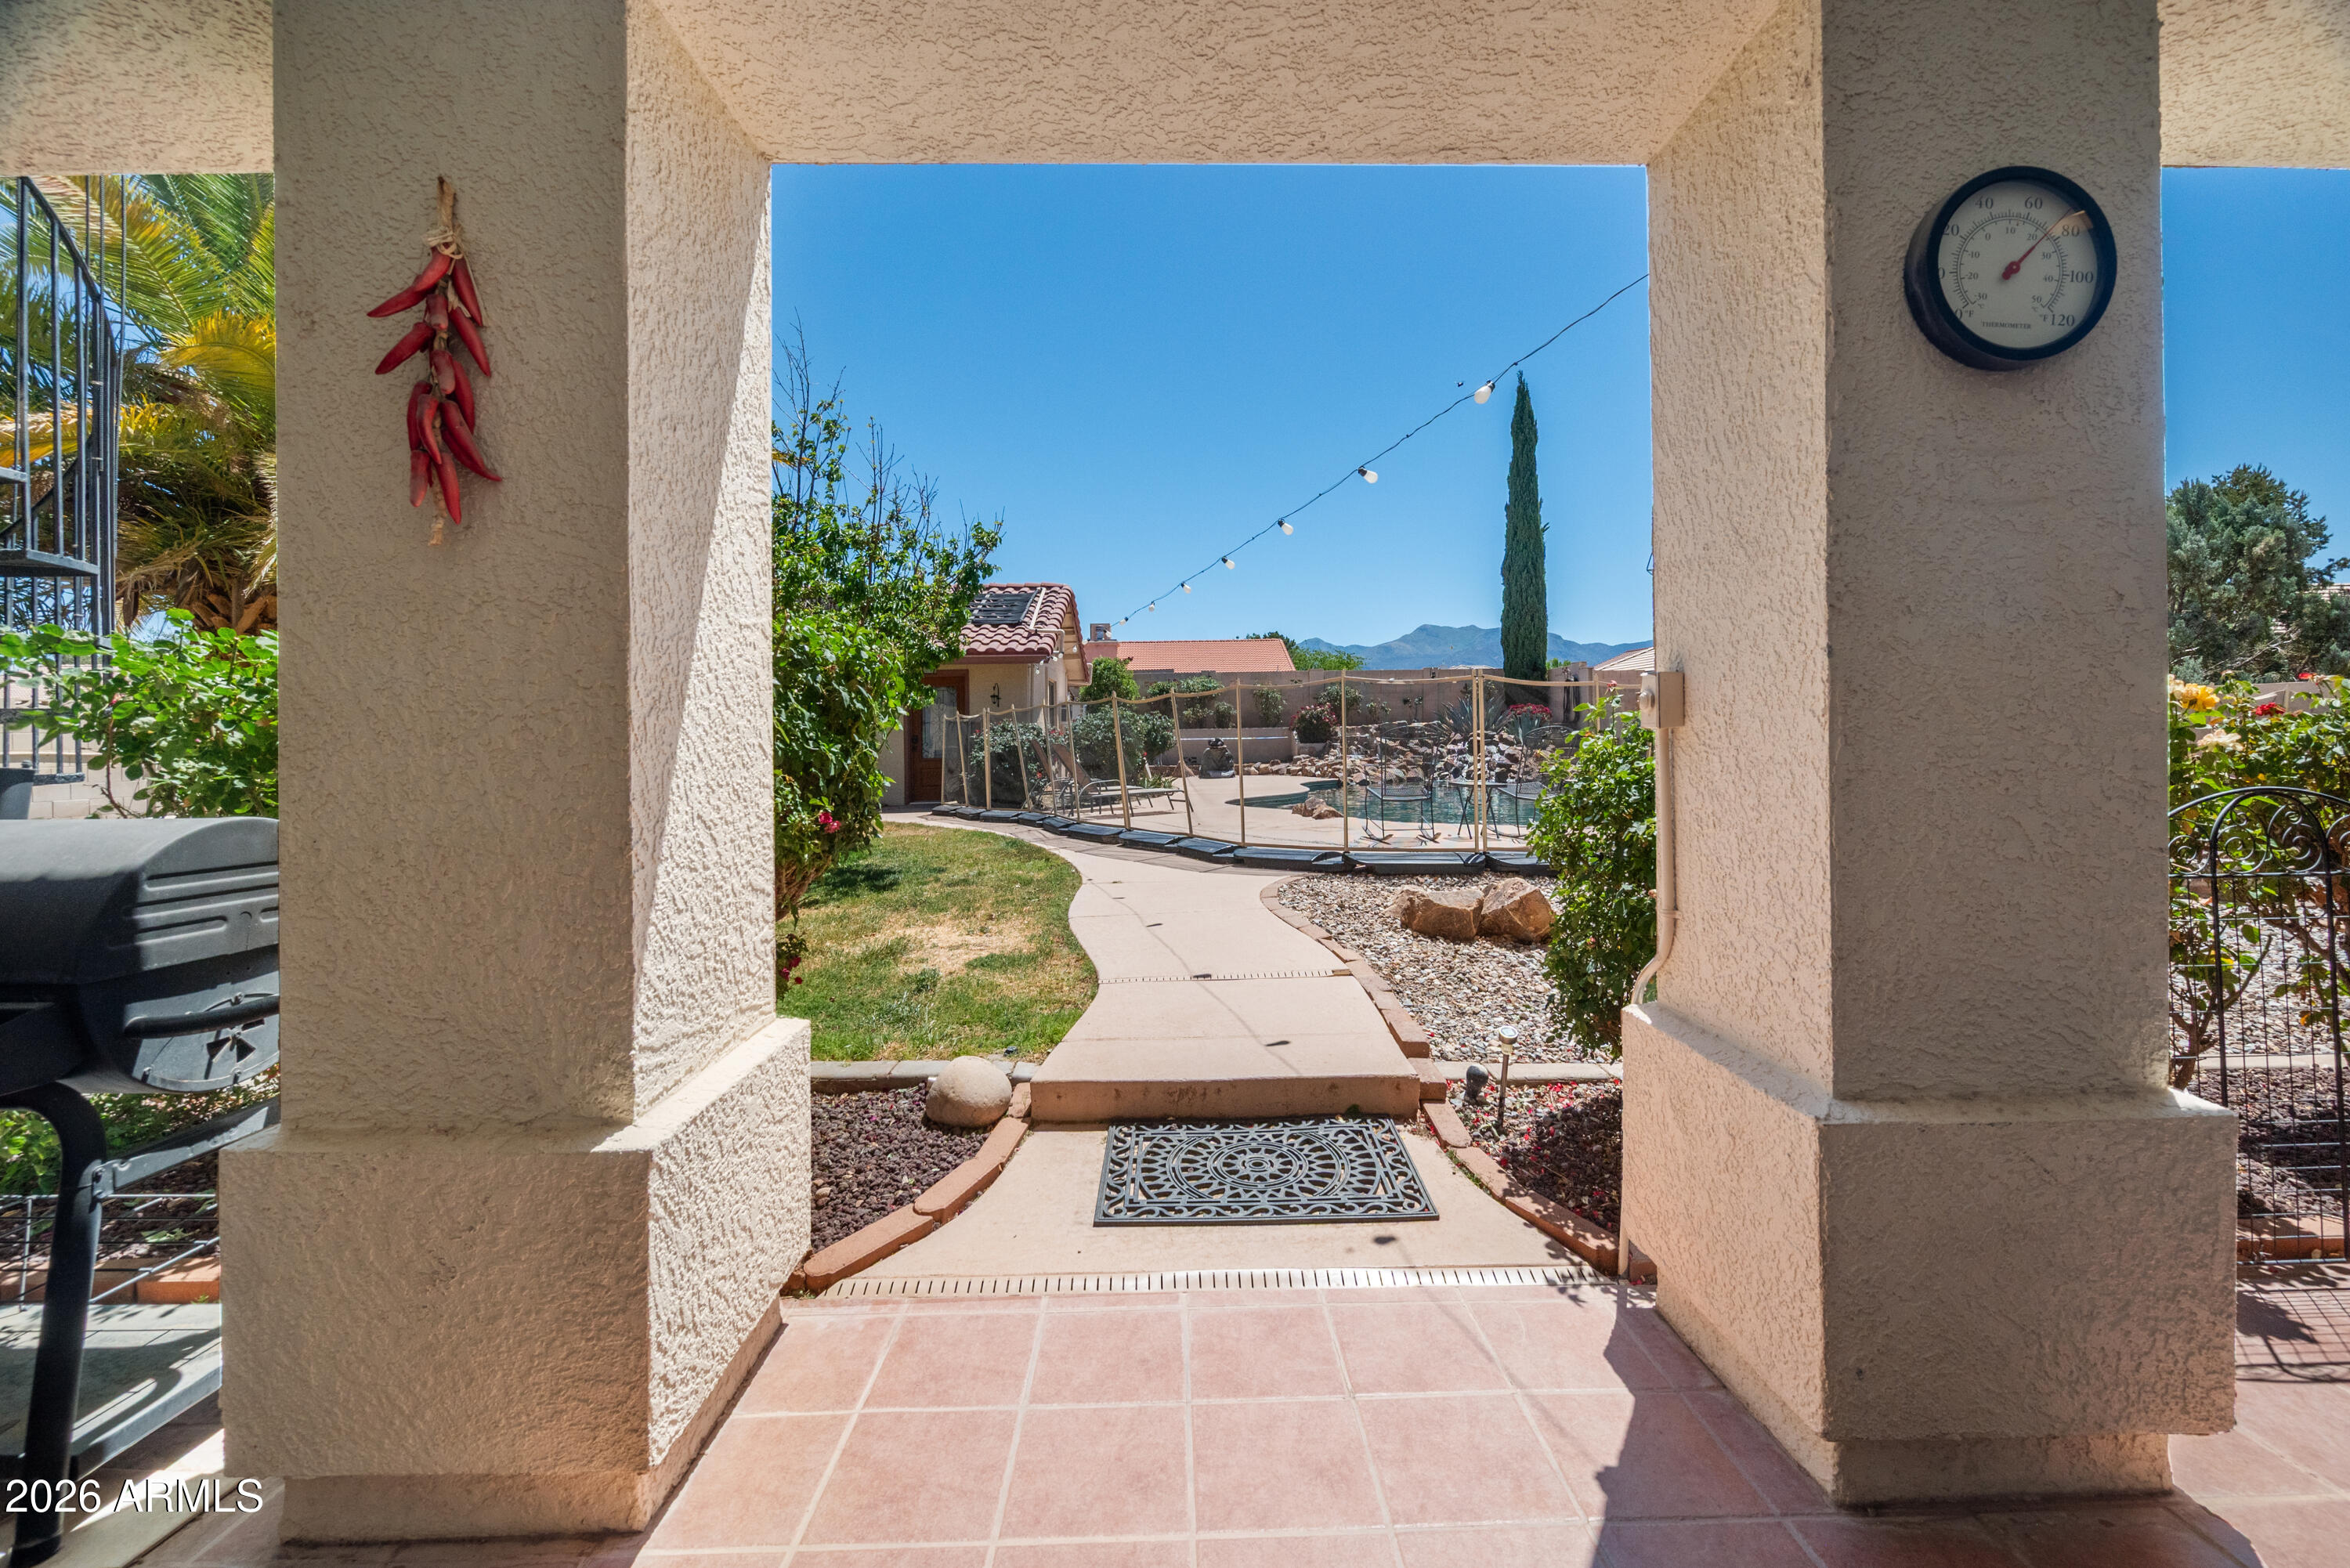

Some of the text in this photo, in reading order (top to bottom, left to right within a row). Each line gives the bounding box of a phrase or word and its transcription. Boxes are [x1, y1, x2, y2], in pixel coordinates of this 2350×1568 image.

[1975, 196, 1994, 209] 40
[2025, 196, 2043, 210] 60
[1943, 224, 1960, 236] 20
[2062, 225, 2080, 237] 80
[2042, 251, 2052, 260] 30
[2070, 270, 2094, 283] 100
[2031, 294, 2042, 303] 50
[2050, 314, 2075, 327] 120
